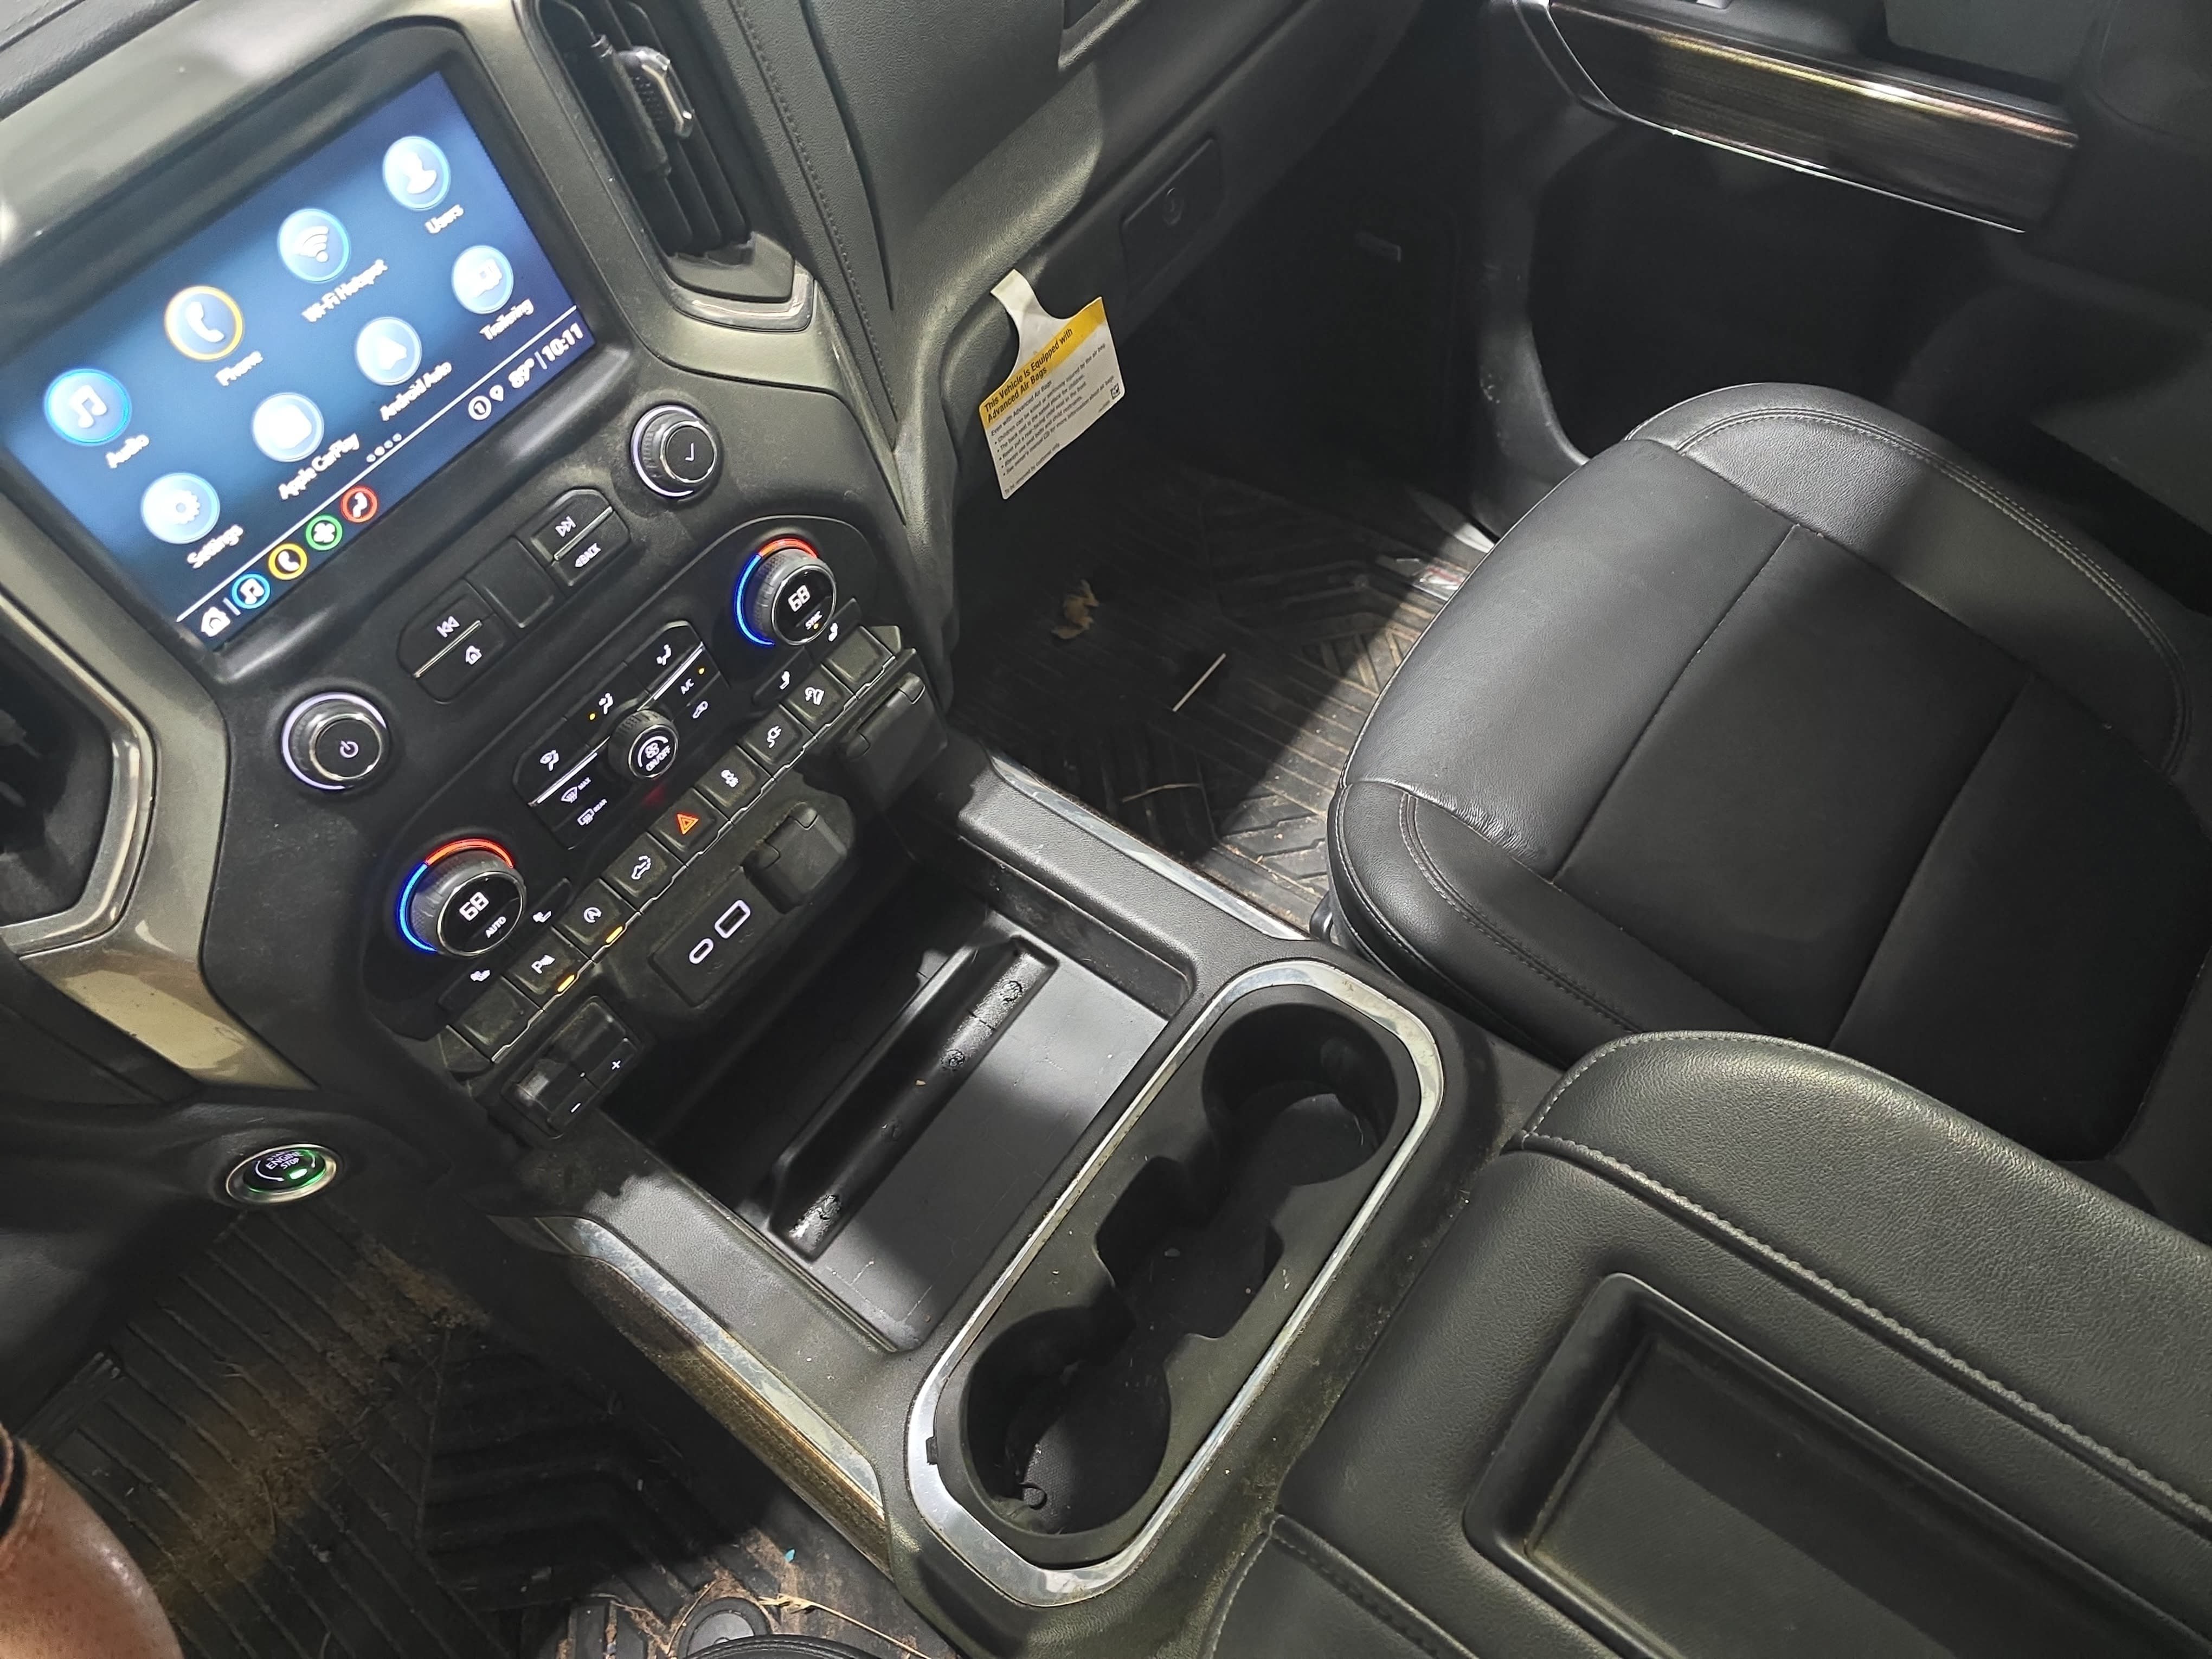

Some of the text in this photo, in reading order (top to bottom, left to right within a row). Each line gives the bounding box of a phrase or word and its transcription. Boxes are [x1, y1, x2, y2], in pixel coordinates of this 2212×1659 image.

[425, 204, 464, 234] Users
[542, 322, 583, 362] 10:11
[983, 397, 999, 412] This
[999, 375, 1023, 399] Vehicle
[1030, 340, 1059, 371] Equipped
[1059, 329, 1073, 344] with
[988, 366, 1047, 423] Advanced Air Bags
[788, 585, 811, 612] 68
[459, 892, 489, 921] 68
[486, 916, 506, 938] AUTO
[280, 1158, 299, 1169] STOP
